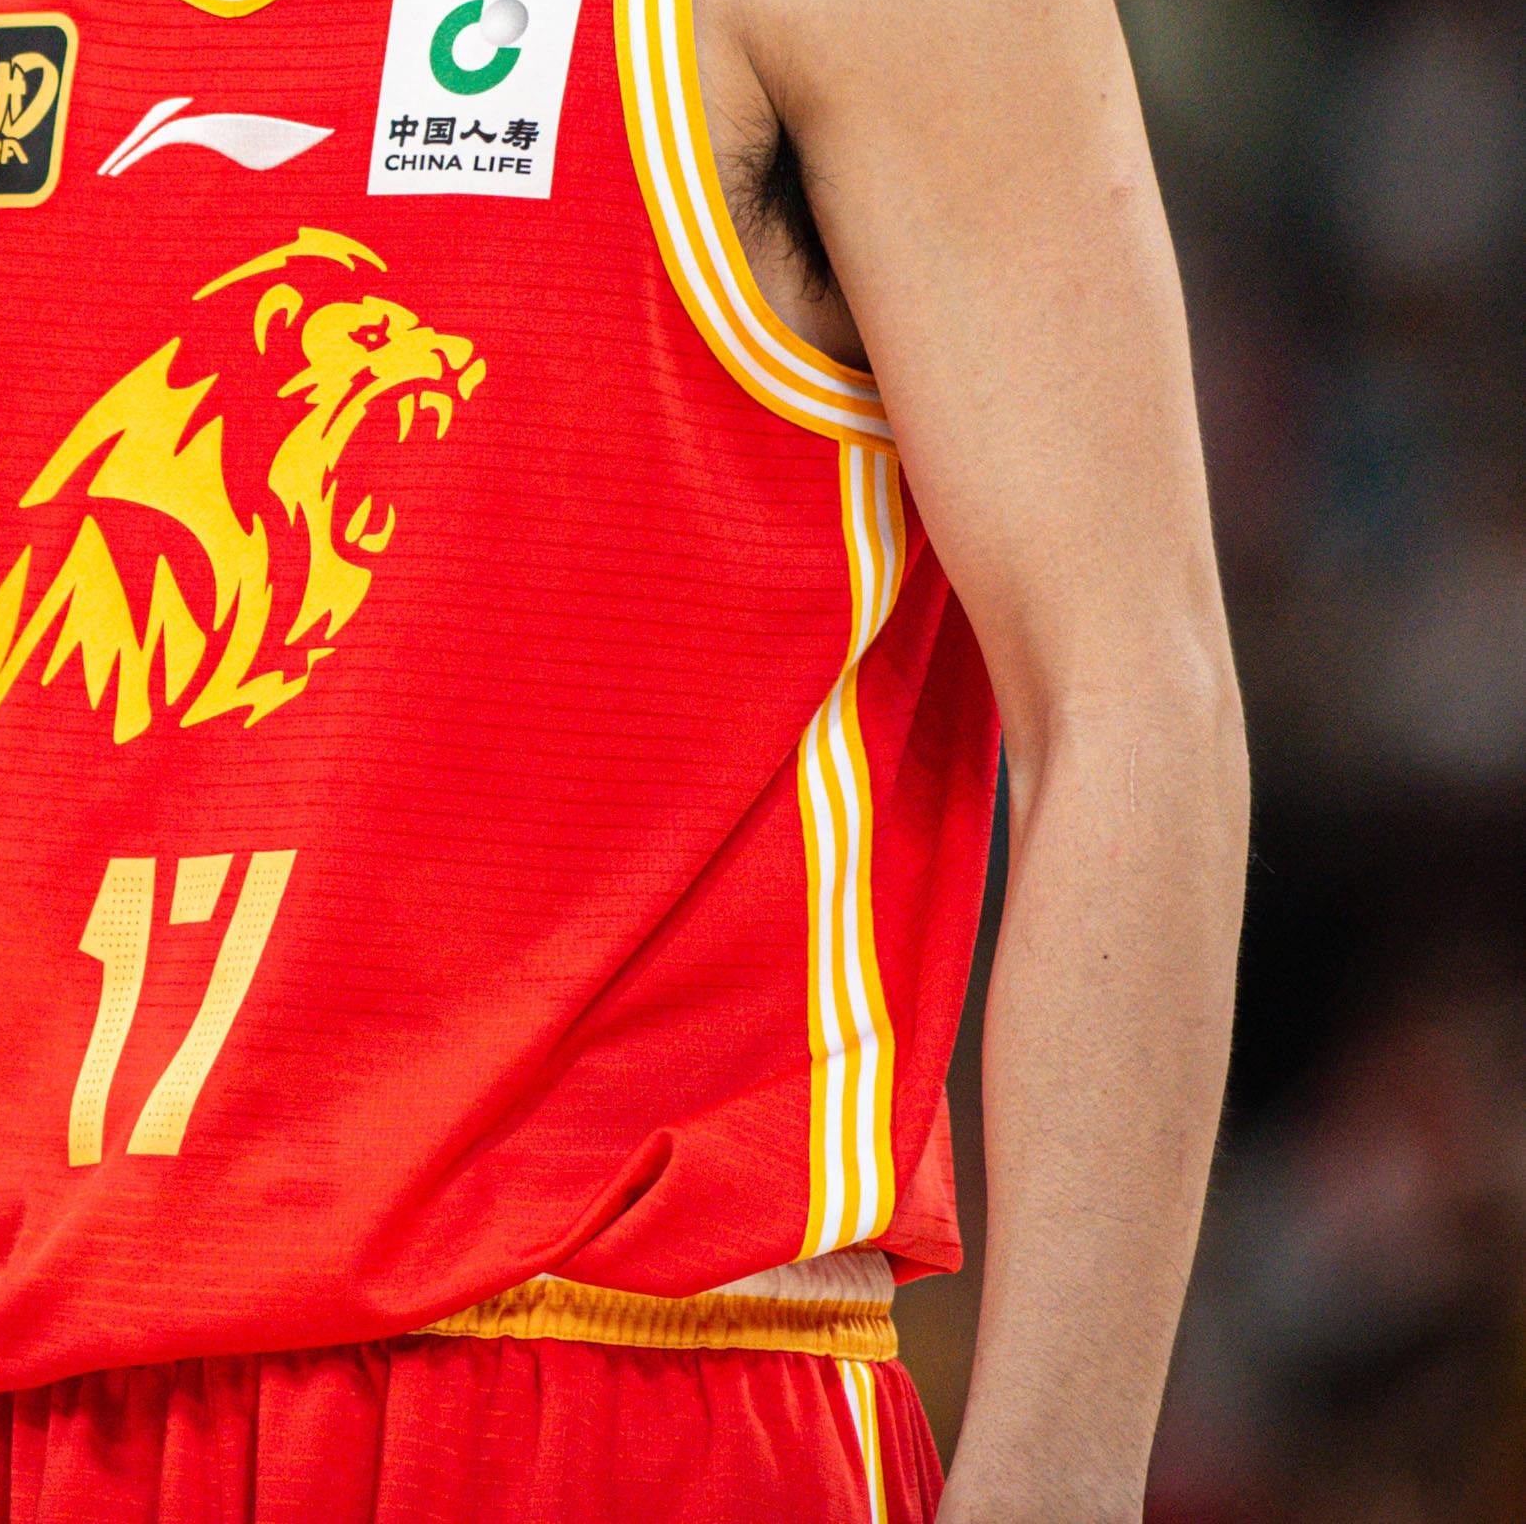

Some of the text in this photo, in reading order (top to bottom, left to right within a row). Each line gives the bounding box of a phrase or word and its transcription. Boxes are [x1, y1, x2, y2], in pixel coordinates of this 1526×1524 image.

[389, 114, 539, 150] 中国人寿
[385, 154, 533, 175] CHINA LIFE
[68, 849, 297, 1167] 17
